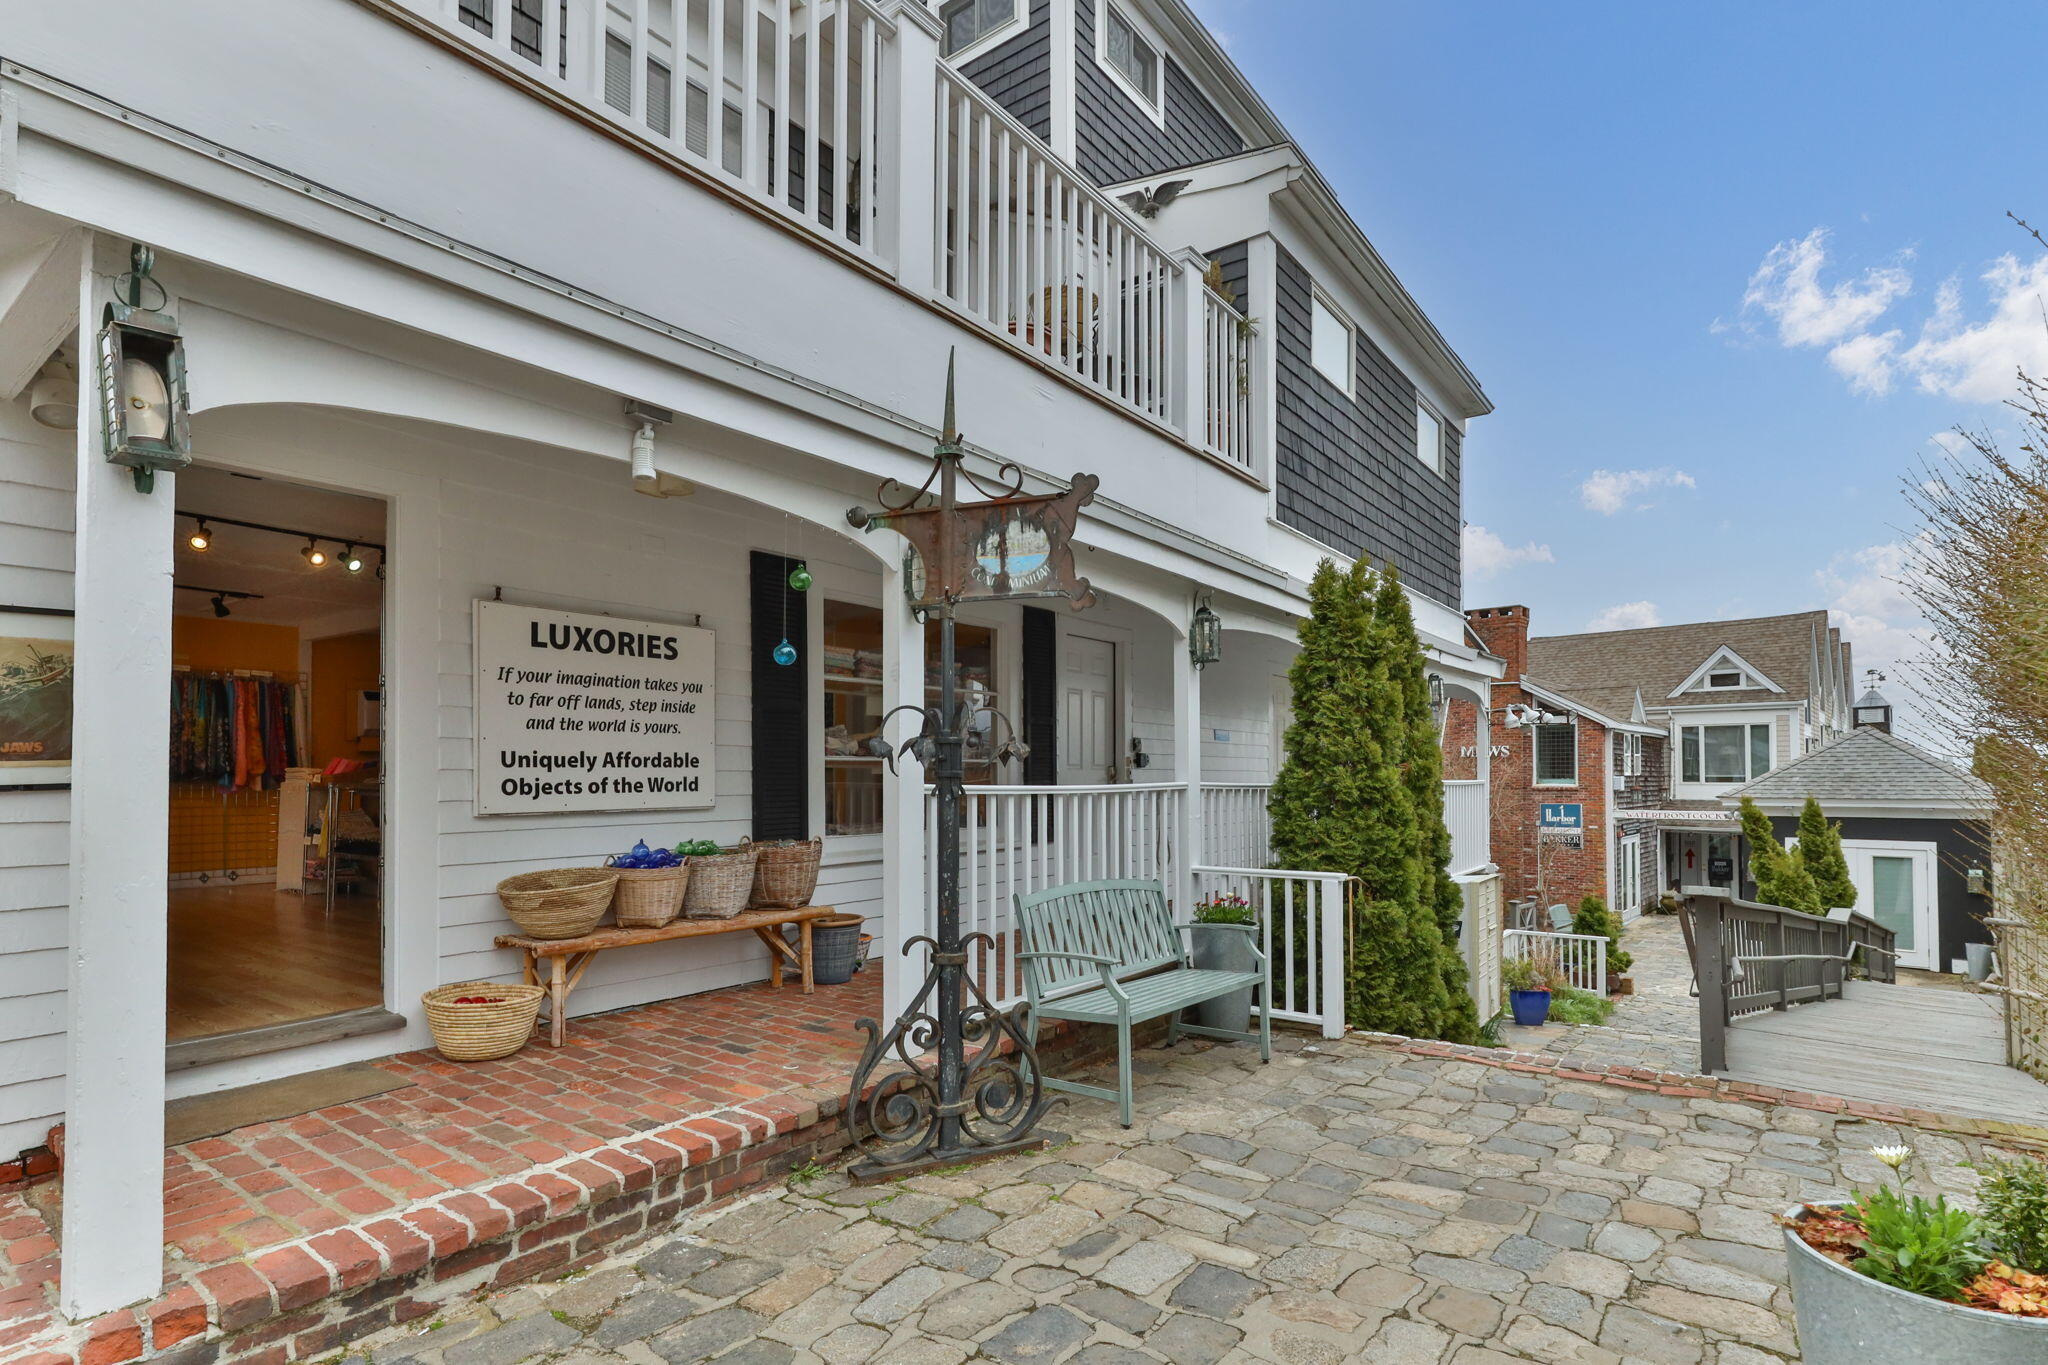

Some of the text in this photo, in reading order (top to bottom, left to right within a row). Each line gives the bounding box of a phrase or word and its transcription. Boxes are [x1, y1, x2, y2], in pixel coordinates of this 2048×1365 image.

[971, 562, 1051, 589] CONMINIUM
[531, 621, 680, 660] LUXORIES
[497, 667, 703, 695] If your imagination takes you
[507, 691, 696, 714] to far off lands, step inside
[526, 717, 680, 735] and the world is yours.
[0, 741, 44, 753] JAWS
[1460, 745, 1510, 758] MWS
[501, 750, 699, 773] Uniquely Affordable
[501, 776, 698, 800] Objects of the World
[1545, 805, 1577, 822] Harbor
